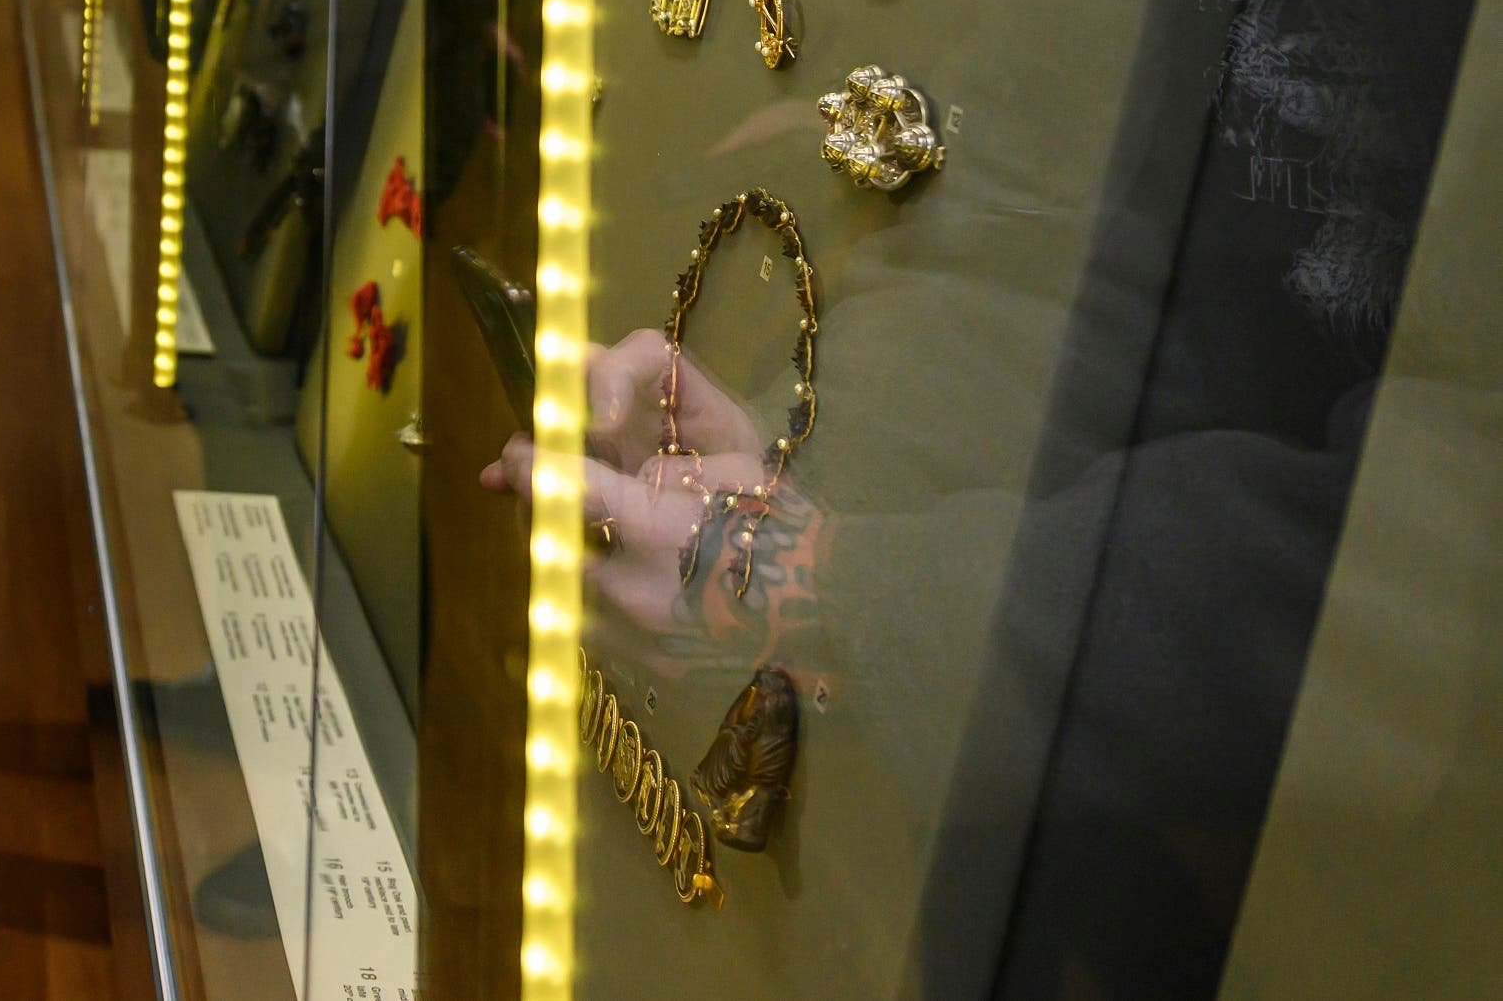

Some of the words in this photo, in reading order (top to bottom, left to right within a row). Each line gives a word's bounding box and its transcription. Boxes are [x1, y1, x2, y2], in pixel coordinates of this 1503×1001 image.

[322, 858, 344, 870] 16
[377, 861, 393, 873] 15
[364, 886, 377, 909] century
[359, 966, 378, 980] 18
